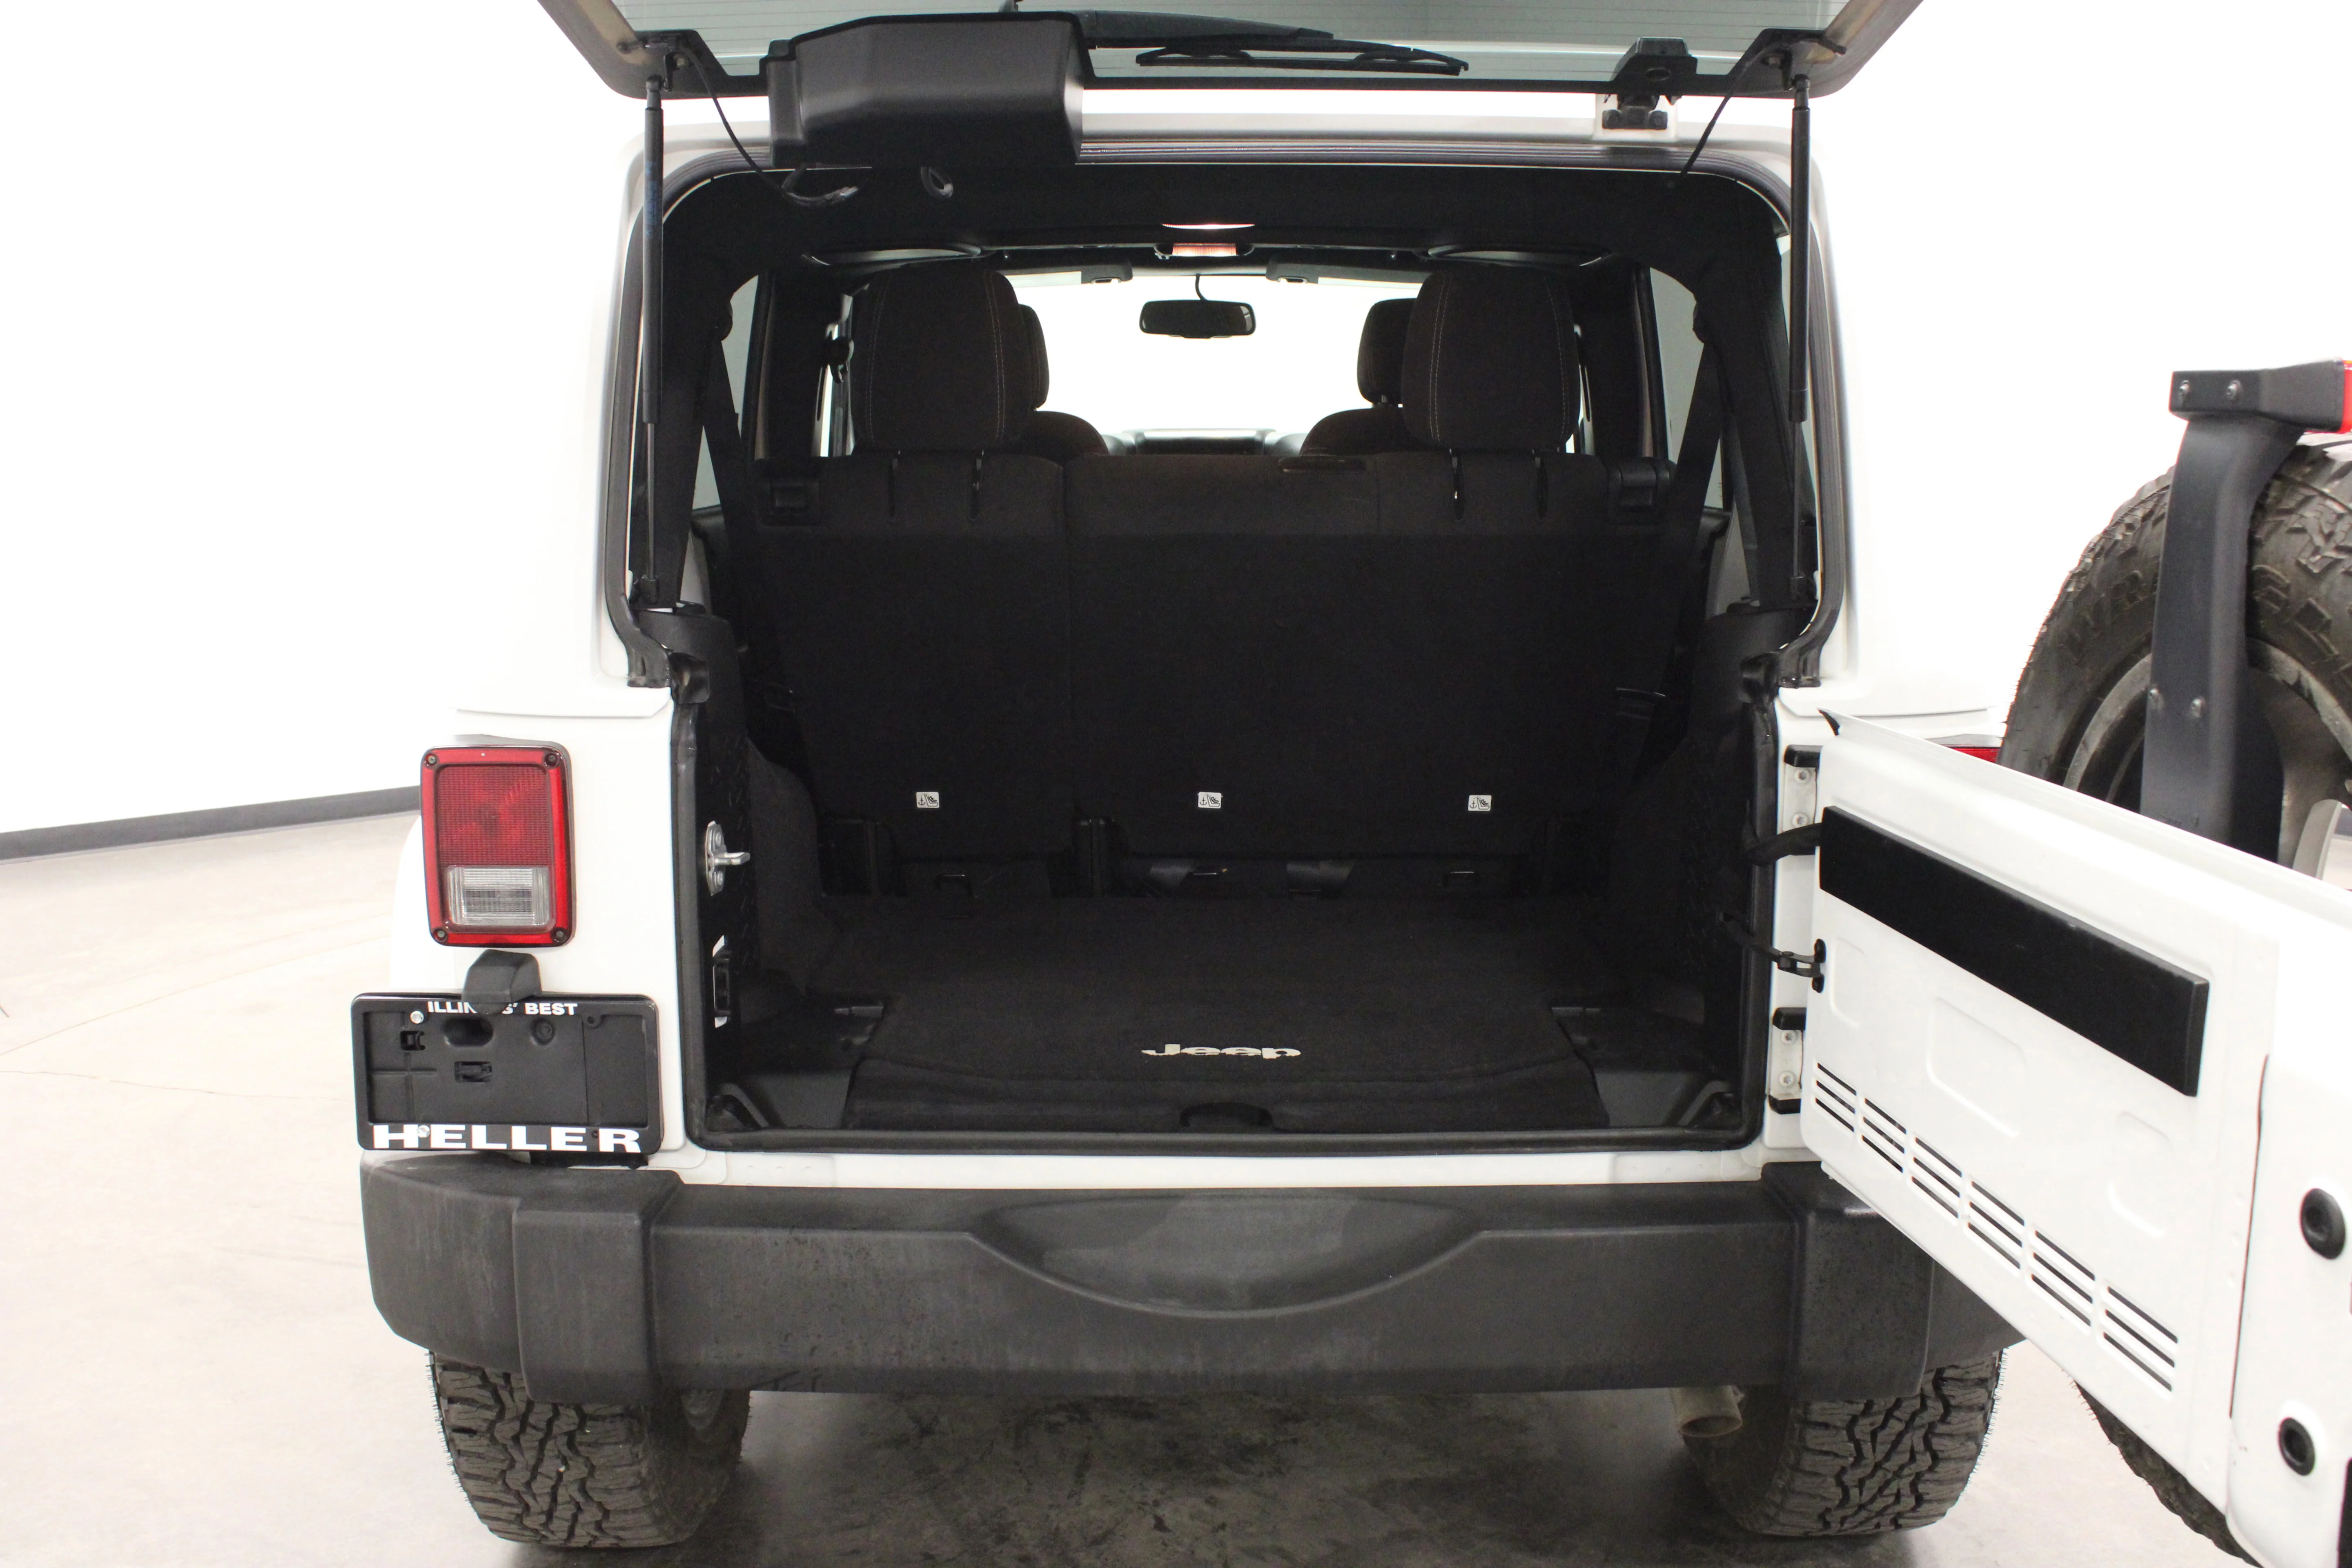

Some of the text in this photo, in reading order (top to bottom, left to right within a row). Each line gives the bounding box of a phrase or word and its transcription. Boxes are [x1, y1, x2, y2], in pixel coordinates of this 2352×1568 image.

[428, 1001, 578, 1016] ILLINS' BEST
[1141, 1044, 1301, 1059] Jeep
[373, 1124, 641, 1153] HELLER
